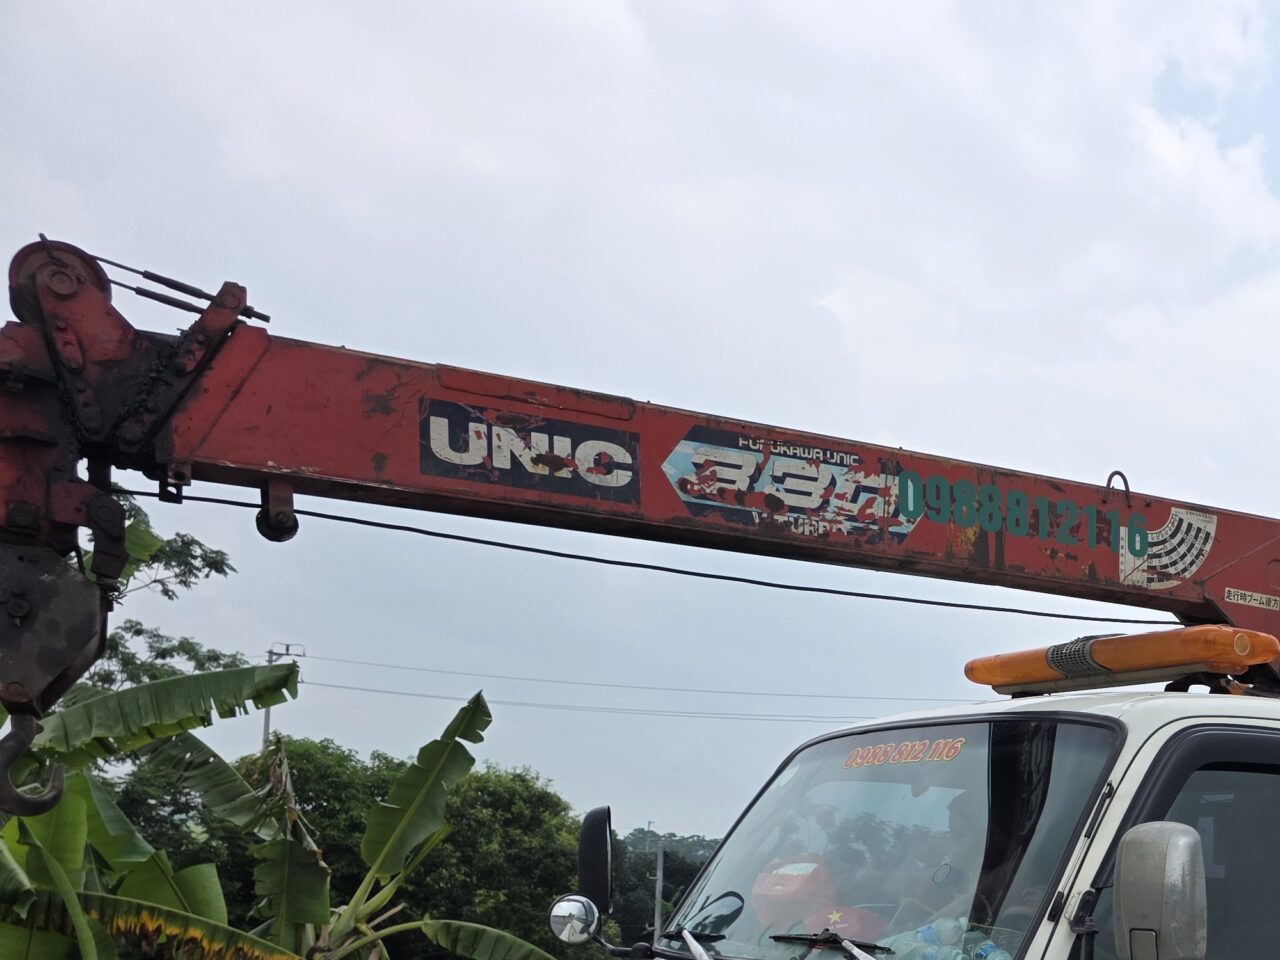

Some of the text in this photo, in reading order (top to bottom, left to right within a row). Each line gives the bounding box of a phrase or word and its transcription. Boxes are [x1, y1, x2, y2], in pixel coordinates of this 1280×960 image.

[430, 415, 633, 488] UNIC
[826, 450, 860, 466] UNIC
[900, 471, 1149, 558] 0988812116
[843, 738, 965, 768] 0988 812 116
